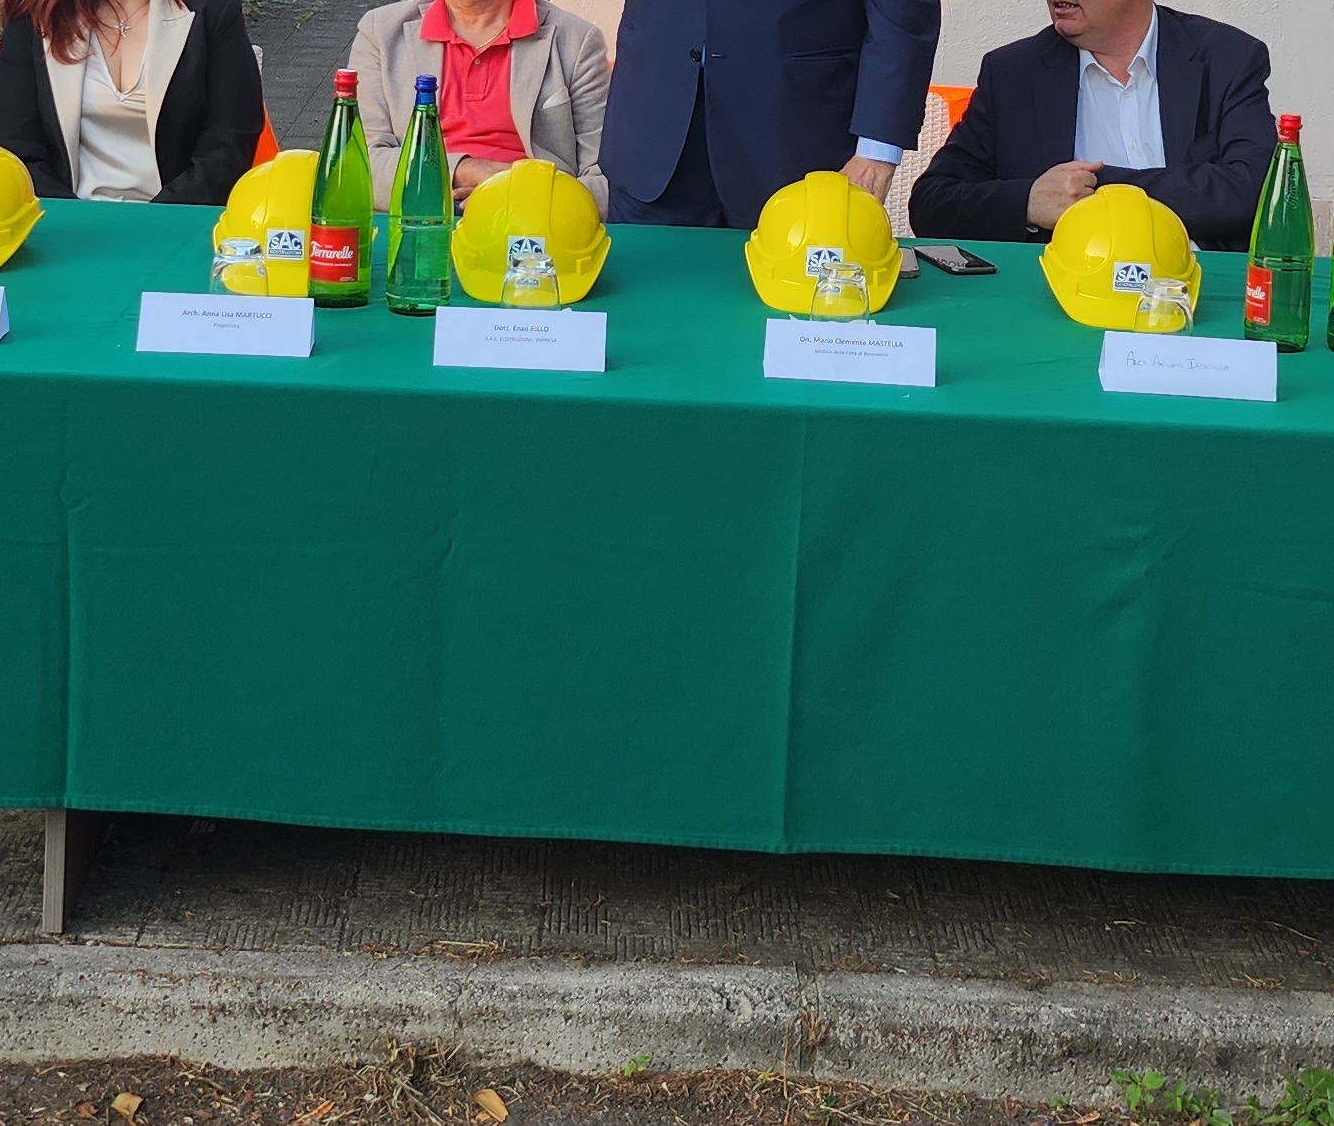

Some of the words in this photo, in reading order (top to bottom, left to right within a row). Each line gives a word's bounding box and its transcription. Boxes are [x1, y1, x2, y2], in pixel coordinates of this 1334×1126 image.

[270, 231, 301, 250] SAC
[511, 238, 542, 254] SAC
[310, 240, 354, 259] Ferrarelle
[1117, 264, 1148, 282] SAC
[182, 309, 200, 317] Arch.
[201, 310, 220, 318] Anna
[235, 311, 273, 319] MARTUCCI
[813, 336, 834, 344] Mario
[868, 339, 904, 348] MASTELLA
